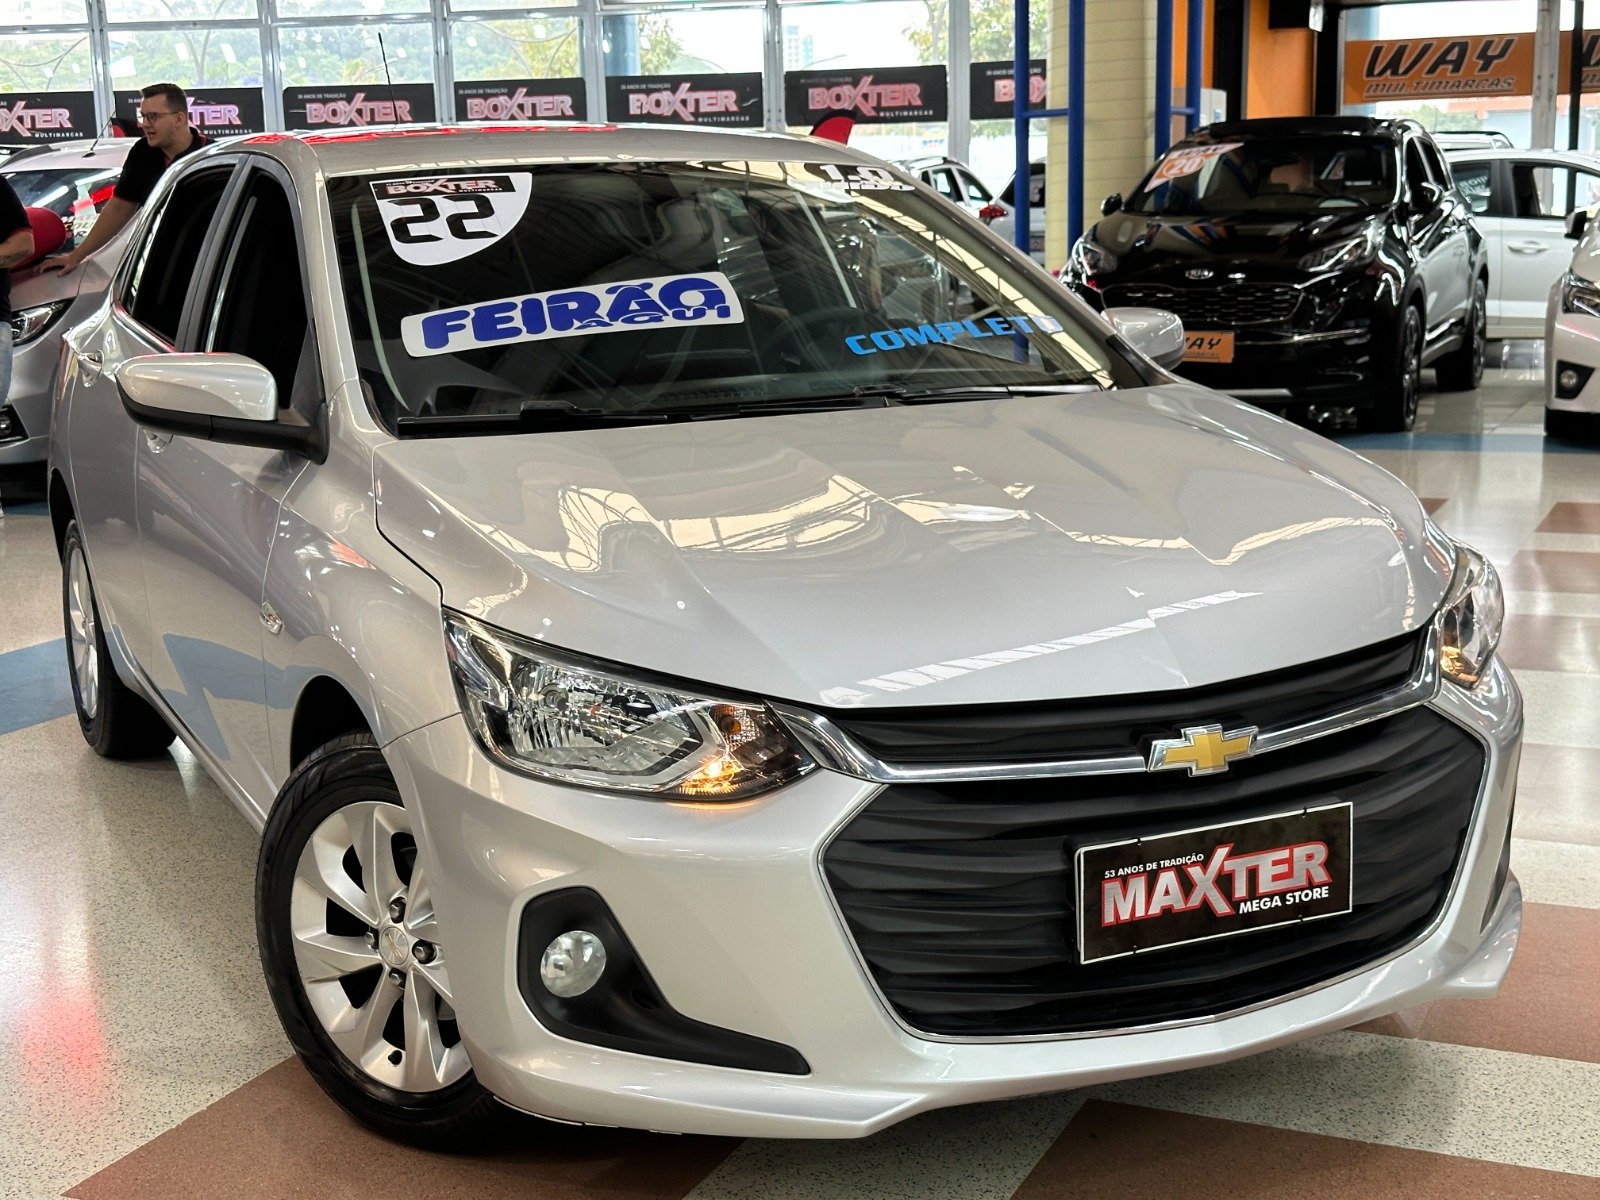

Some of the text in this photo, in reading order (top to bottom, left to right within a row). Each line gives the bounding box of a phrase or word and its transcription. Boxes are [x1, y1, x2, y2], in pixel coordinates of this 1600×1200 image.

[1364, 37, 1518, 79] WAY
[628, 82, 739, 121] BOXTER
[808, 75, 922, 116] BOXTER
[1366, 76, 1516, 95] MULTIMARCAS
[306, 93, 413, 126] BOXTER
[466, 87, 574, 120] BOXTER
[387, 178, 499, 195] BOXTER
[820, 164, 894, 184] 1.0
[387, 194, 499, 244] 22
[421, 277, 727, 350] FEIRÃO
[574, 305, 731, 331] AQUI
[845, 315, 1064, 356] COMPLETO
[1186, 336, 1222, 351] AY
[1104, 852, 1205, 879] 53 ANOS DE TRADIÇÃO
[1102, 840, 1333, 927] MAXTER
[1239, 886, 1329, 914] MEGA STORE
